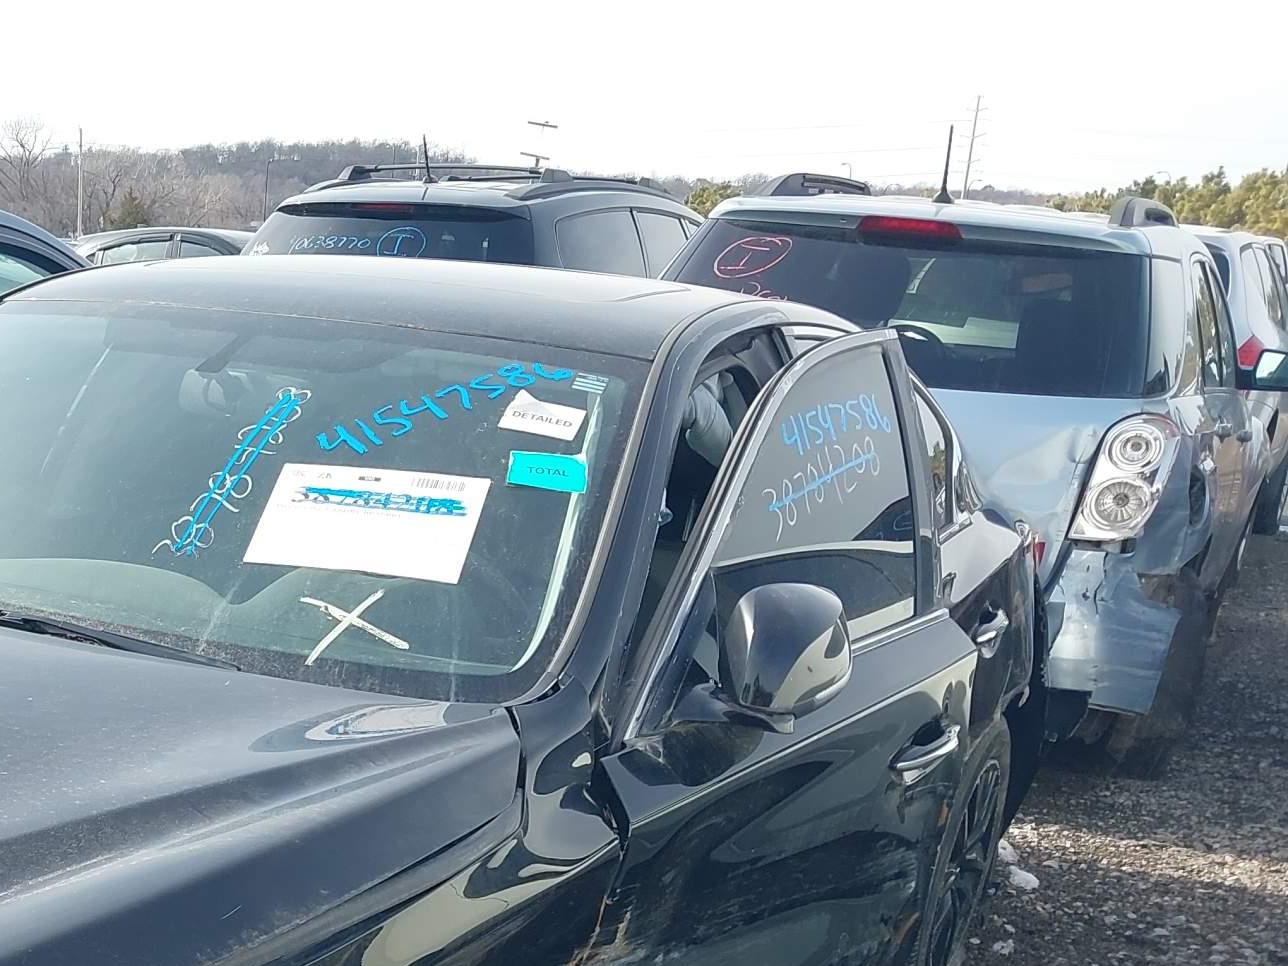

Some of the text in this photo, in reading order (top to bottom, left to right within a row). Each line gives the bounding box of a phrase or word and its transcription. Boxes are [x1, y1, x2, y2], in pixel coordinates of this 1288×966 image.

[316, 362, 574, 455] 41547586
[511, 409, 574, 429] DETAILED
[781, 393, 892, 455] 41547586
[527, 465, 569, 477] TOTAL
